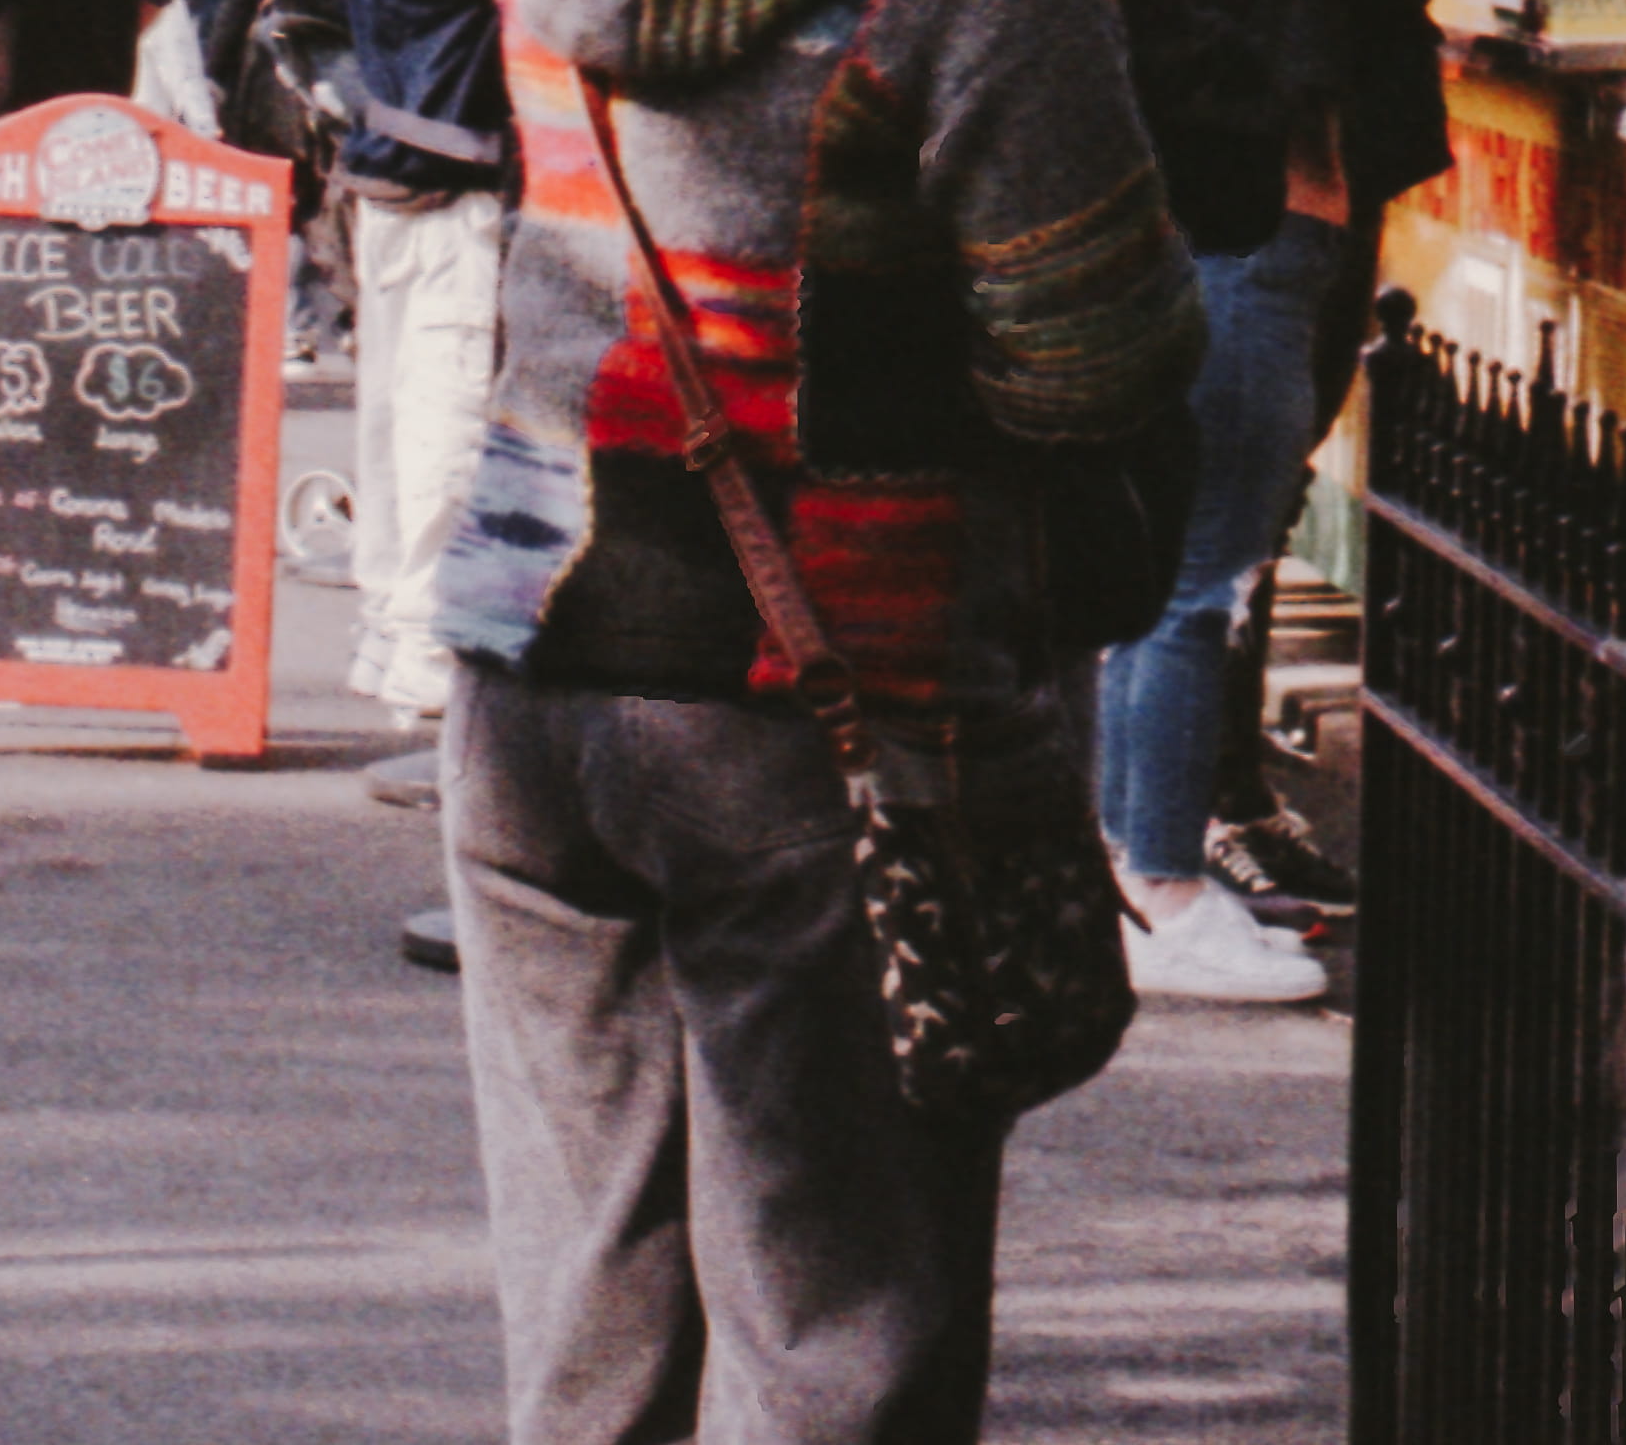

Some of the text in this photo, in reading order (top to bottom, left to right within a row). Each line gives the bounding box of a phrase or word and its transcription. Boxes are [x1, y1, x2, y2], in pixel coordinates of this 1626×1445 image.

[164, 162, 273, 215] BEER
[24, 283, 183, 342] BEER
[106, 352, 165, 401] $6
